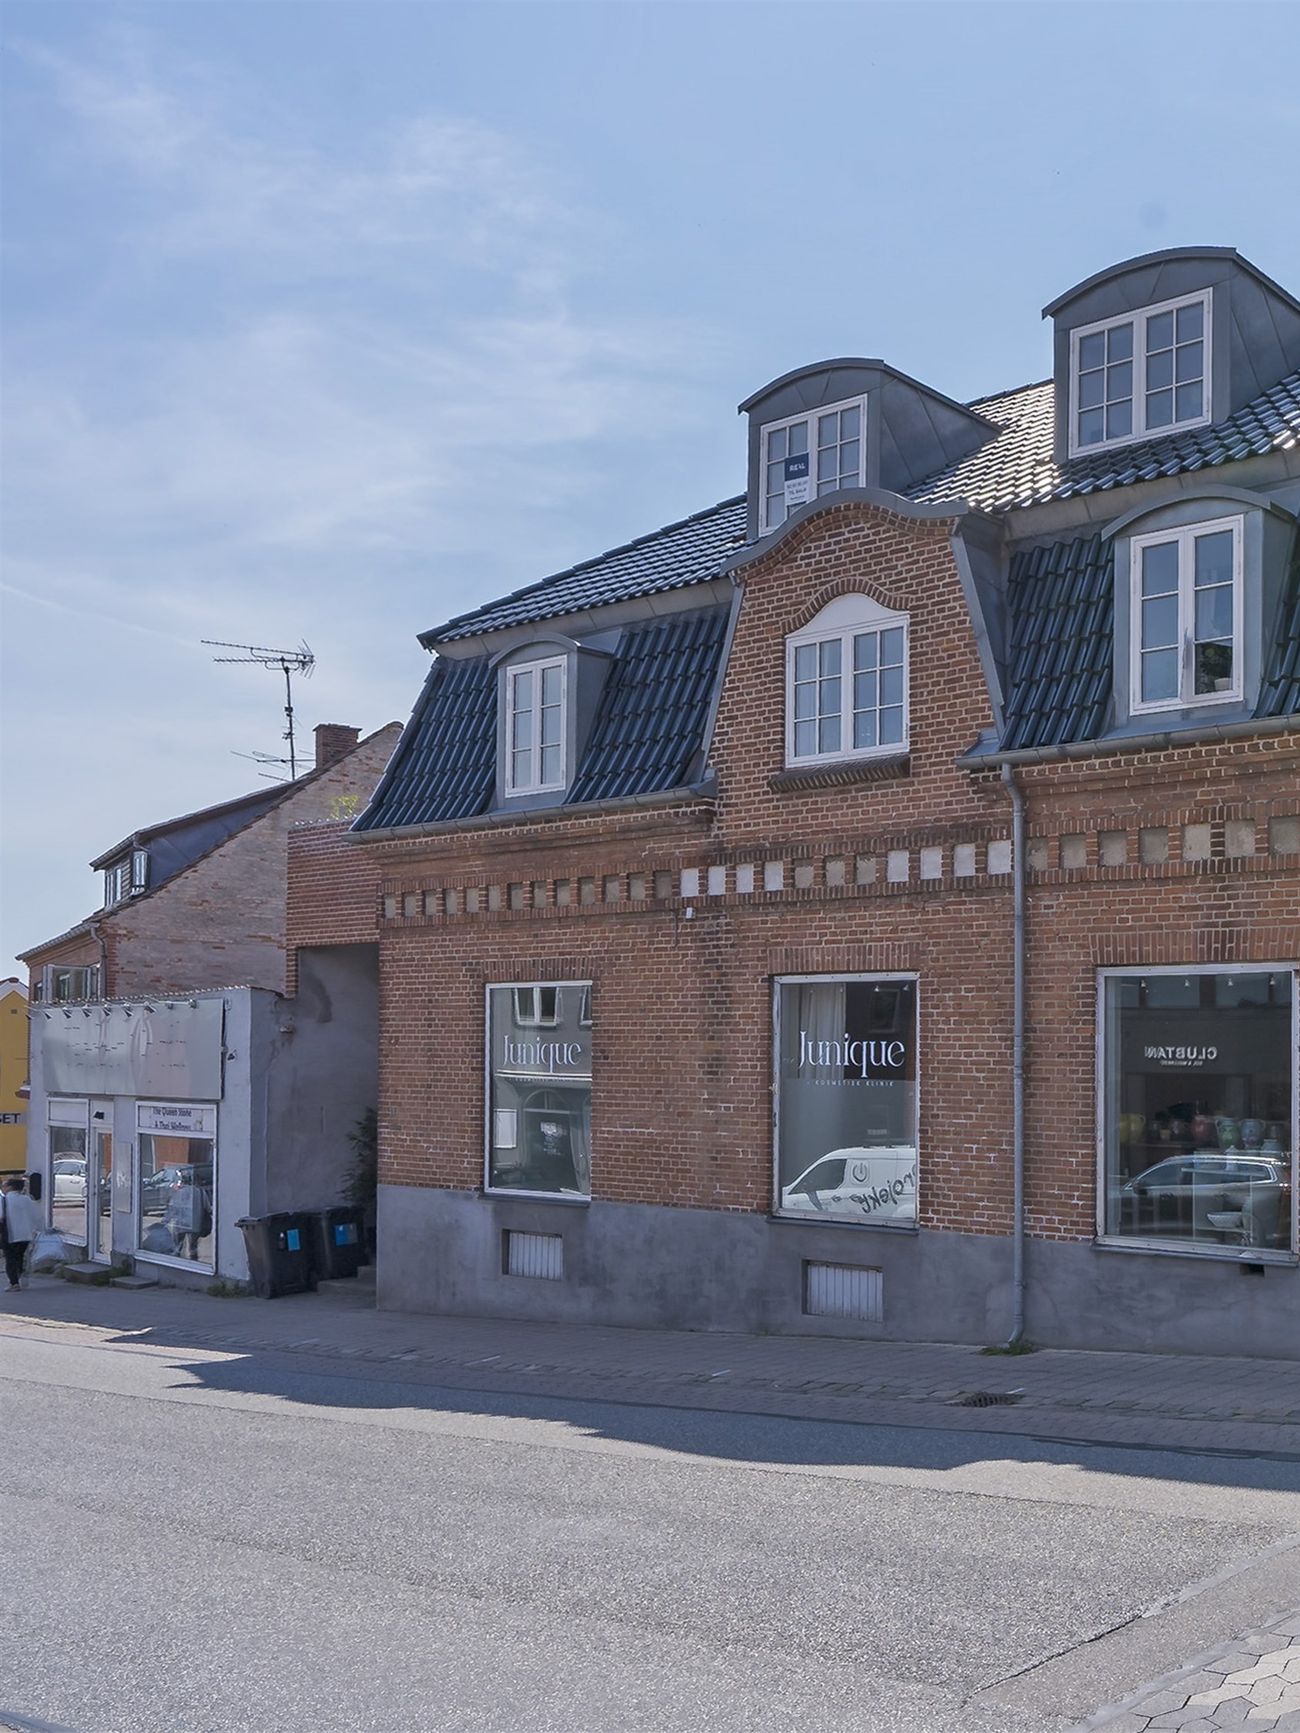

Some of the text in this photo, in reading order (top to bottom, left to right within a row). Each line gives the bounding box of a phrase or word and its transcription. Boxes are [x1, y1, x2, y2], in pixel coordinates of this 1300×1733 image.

[503, 1035, 582, 1075] Junique
[799, 1031, 905, 1078] Junique
[0, 1113, 21, 1124] ET
